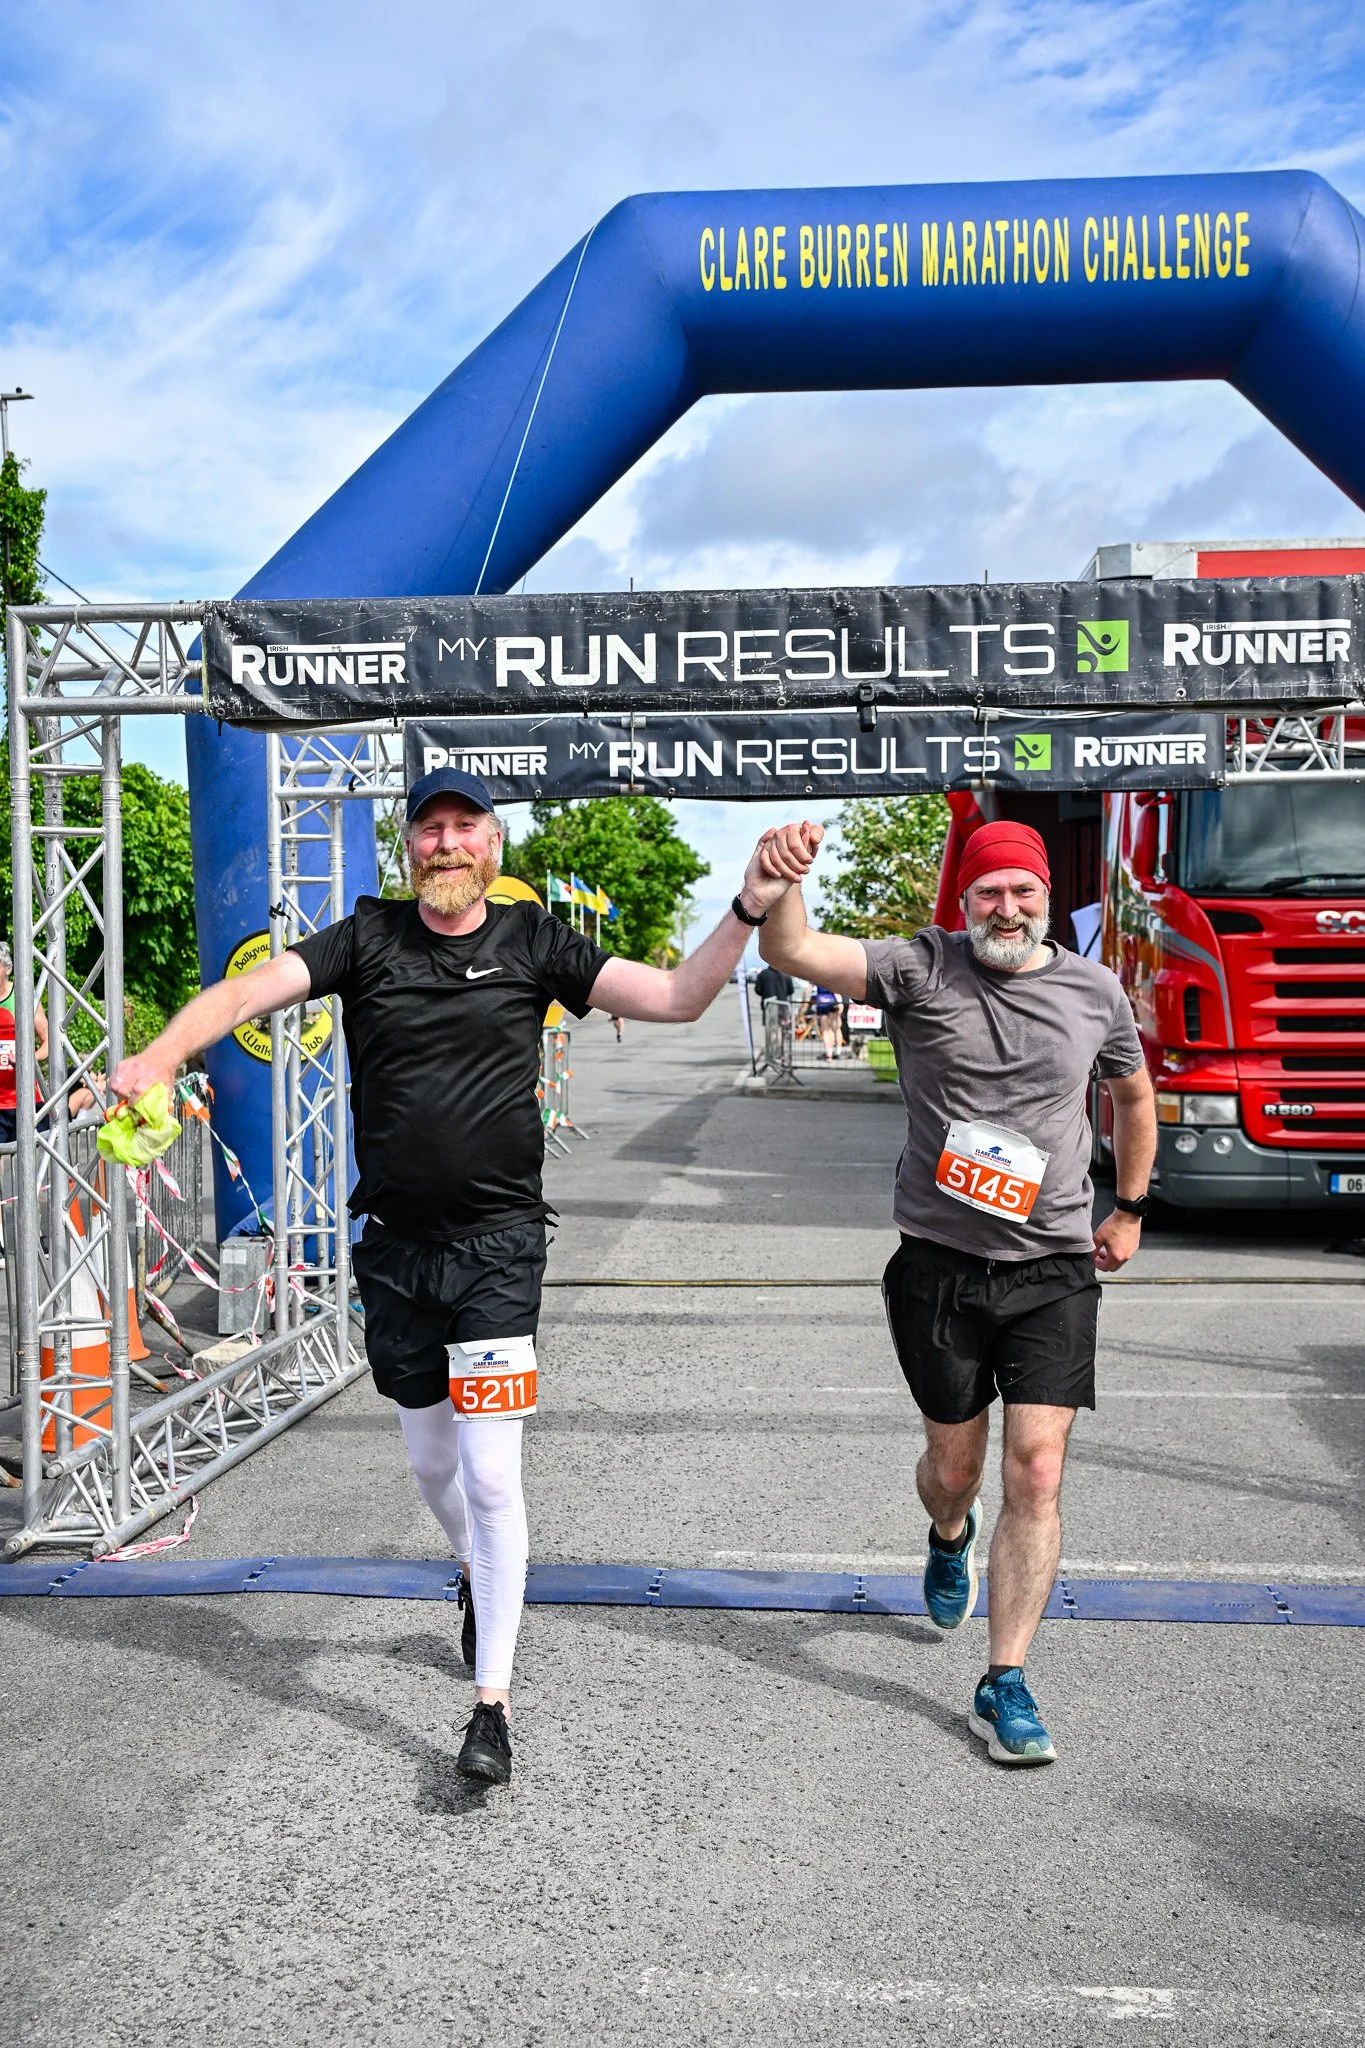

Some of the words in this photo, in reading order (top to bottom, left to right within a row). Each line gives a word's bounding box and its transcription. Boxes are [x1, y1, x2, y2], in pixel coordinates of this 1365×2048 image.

[700, 226, 787, 291] CLARE
[800, 222, 908, 289] BURREN
[921, 217, 1070, 287] MARATHON
[1084, 211, 1250, 282] CHALLENGE
[1163, 623, 1350, 667] RUNNER
[1206, 623, 1227, 631] IRISH
[231, 644, 407, 686] RUNNER
[438, 637, 487, 662] MY
[496, 632, 656, 688] RUN
[677, 623, 1055, 683] RESULTS
[423, 746, 548, 776] RUNNER
[569, 742, 604, 760] MY
[610, 740, 722, 778] RUN
[736, 736, 1001, 776] RESULTS
[1074, 736, 1206, 767] RUNNER
[300, 1035, 323, 1052] lub
[946, 1158, 1024, 1209] 5145
[461, 1376, 525, 1410] 5211
